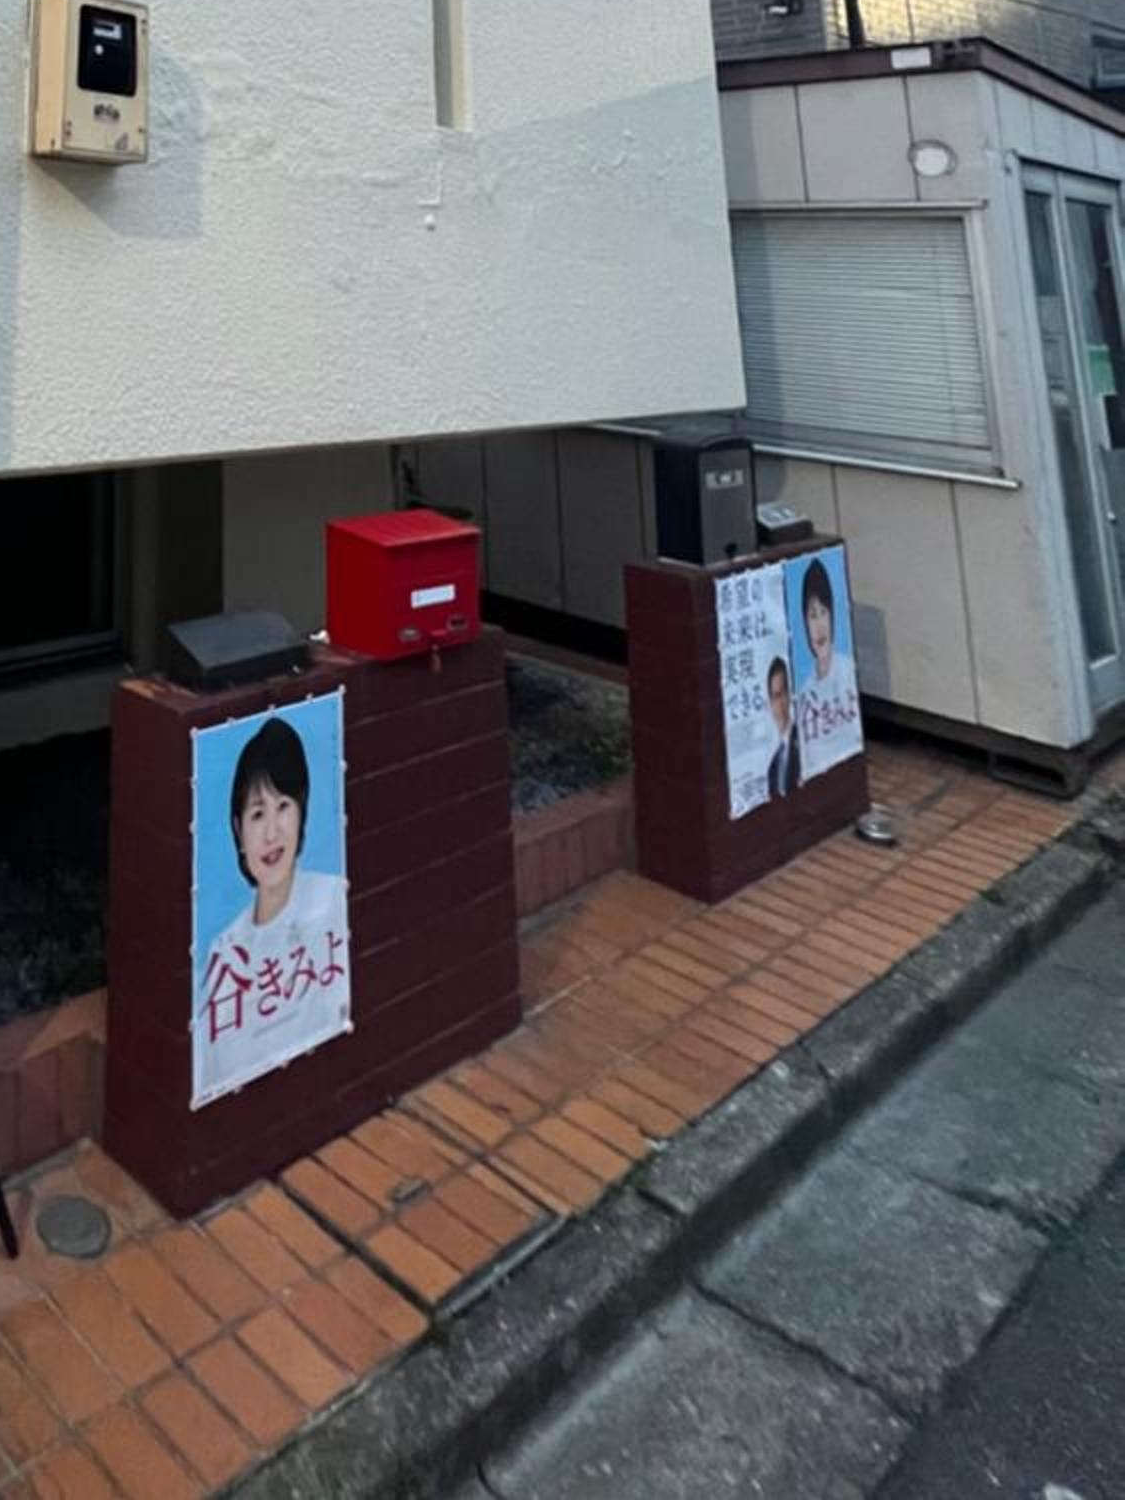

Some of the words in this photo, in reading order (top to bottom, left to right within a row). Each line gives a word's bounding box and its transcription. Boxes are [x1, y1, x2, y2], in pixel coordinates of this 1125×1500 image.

[797, 688, 857, 743] 谷きみよ
[199, 931, 345, 1043] 谷きみよ
